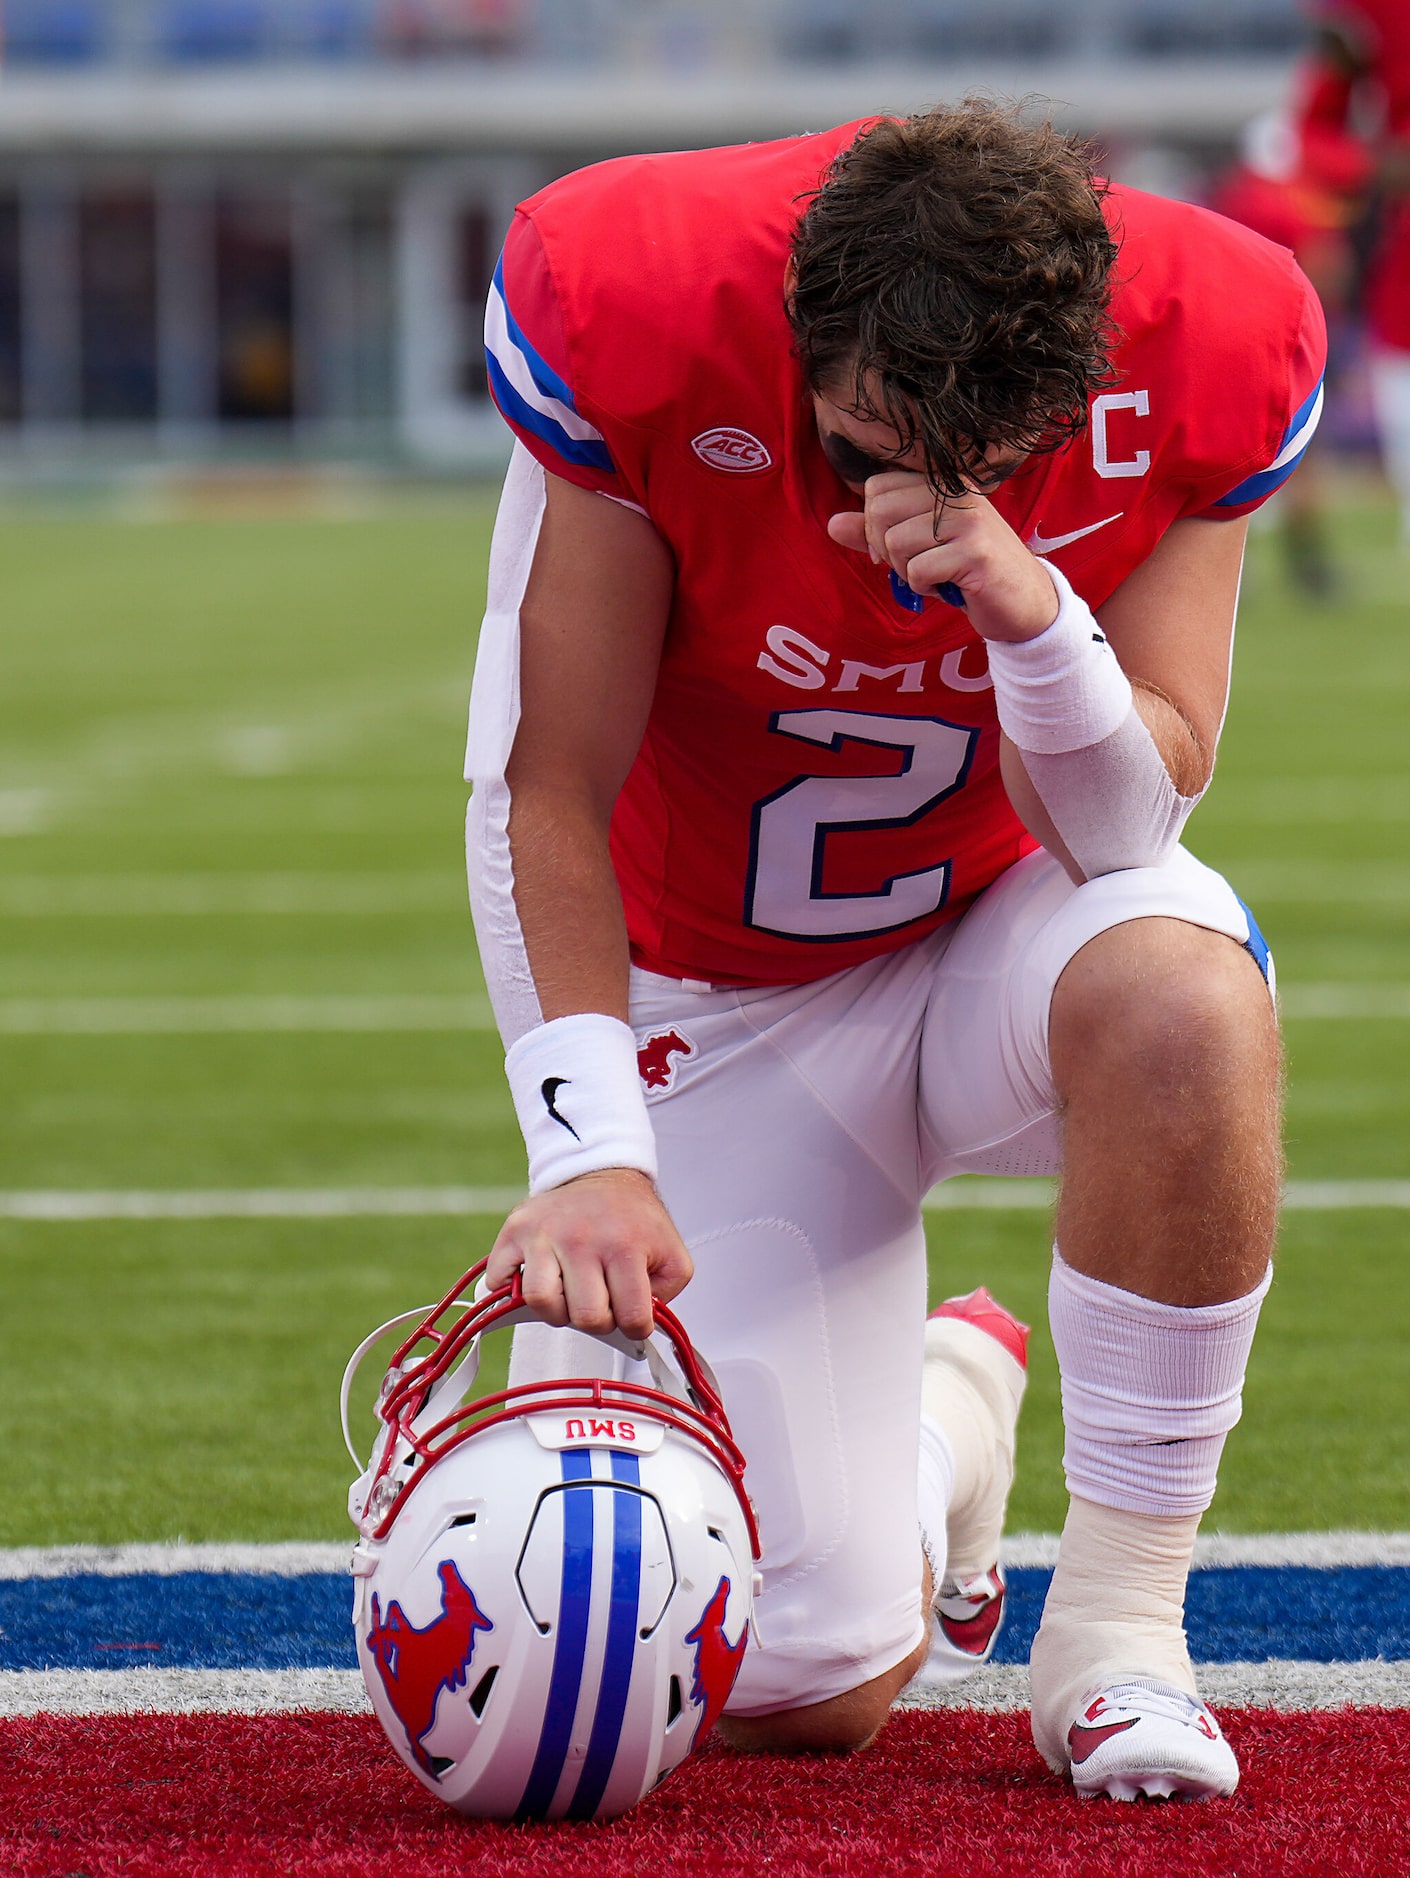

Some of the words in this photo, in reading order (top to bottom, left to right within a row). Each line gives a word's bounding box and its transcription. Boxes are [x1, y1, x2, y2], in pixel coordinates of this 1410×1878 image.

[702, 438, 761, 462] ACC
[1091, 389, 1151, 479] C
[757, 624, 996, 693] SMU
[743, 707, 981, 943] 2
[565, 1418, 636, 1441] SMU
